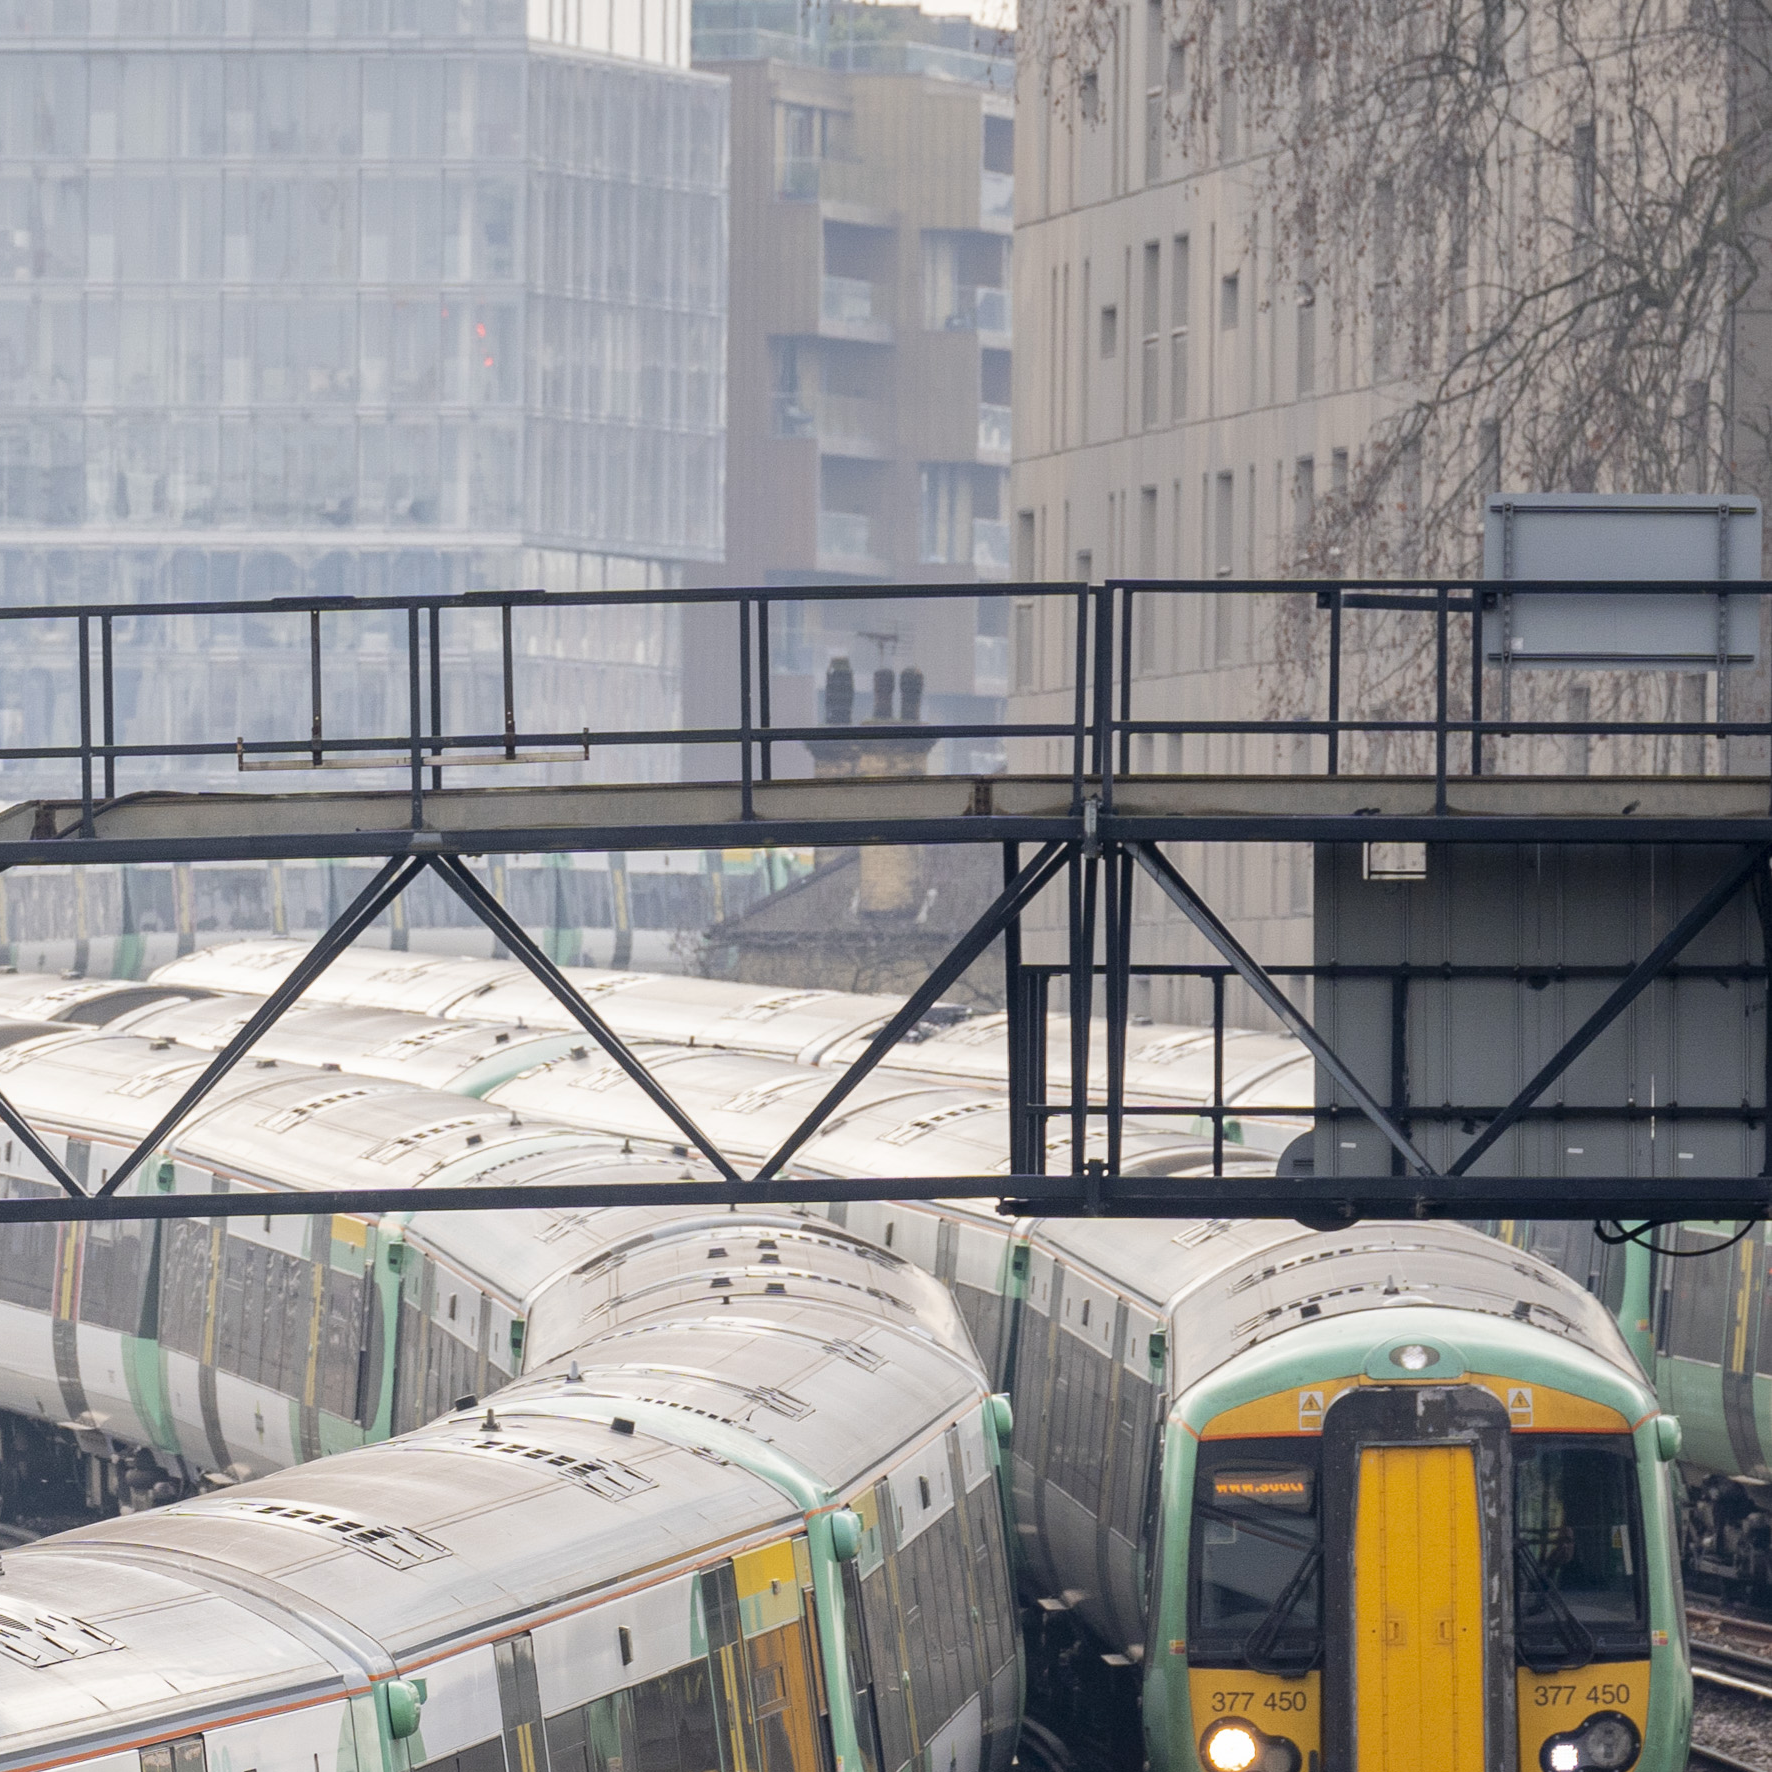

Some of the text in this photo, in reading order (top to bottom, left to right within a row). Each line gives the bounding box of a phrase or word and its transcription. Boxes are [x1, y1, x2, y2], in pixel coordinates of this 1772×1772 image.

[1211, 1690, 1307, 1713] 377 450
[1534, 1683, 1630, 1707] 377 450
